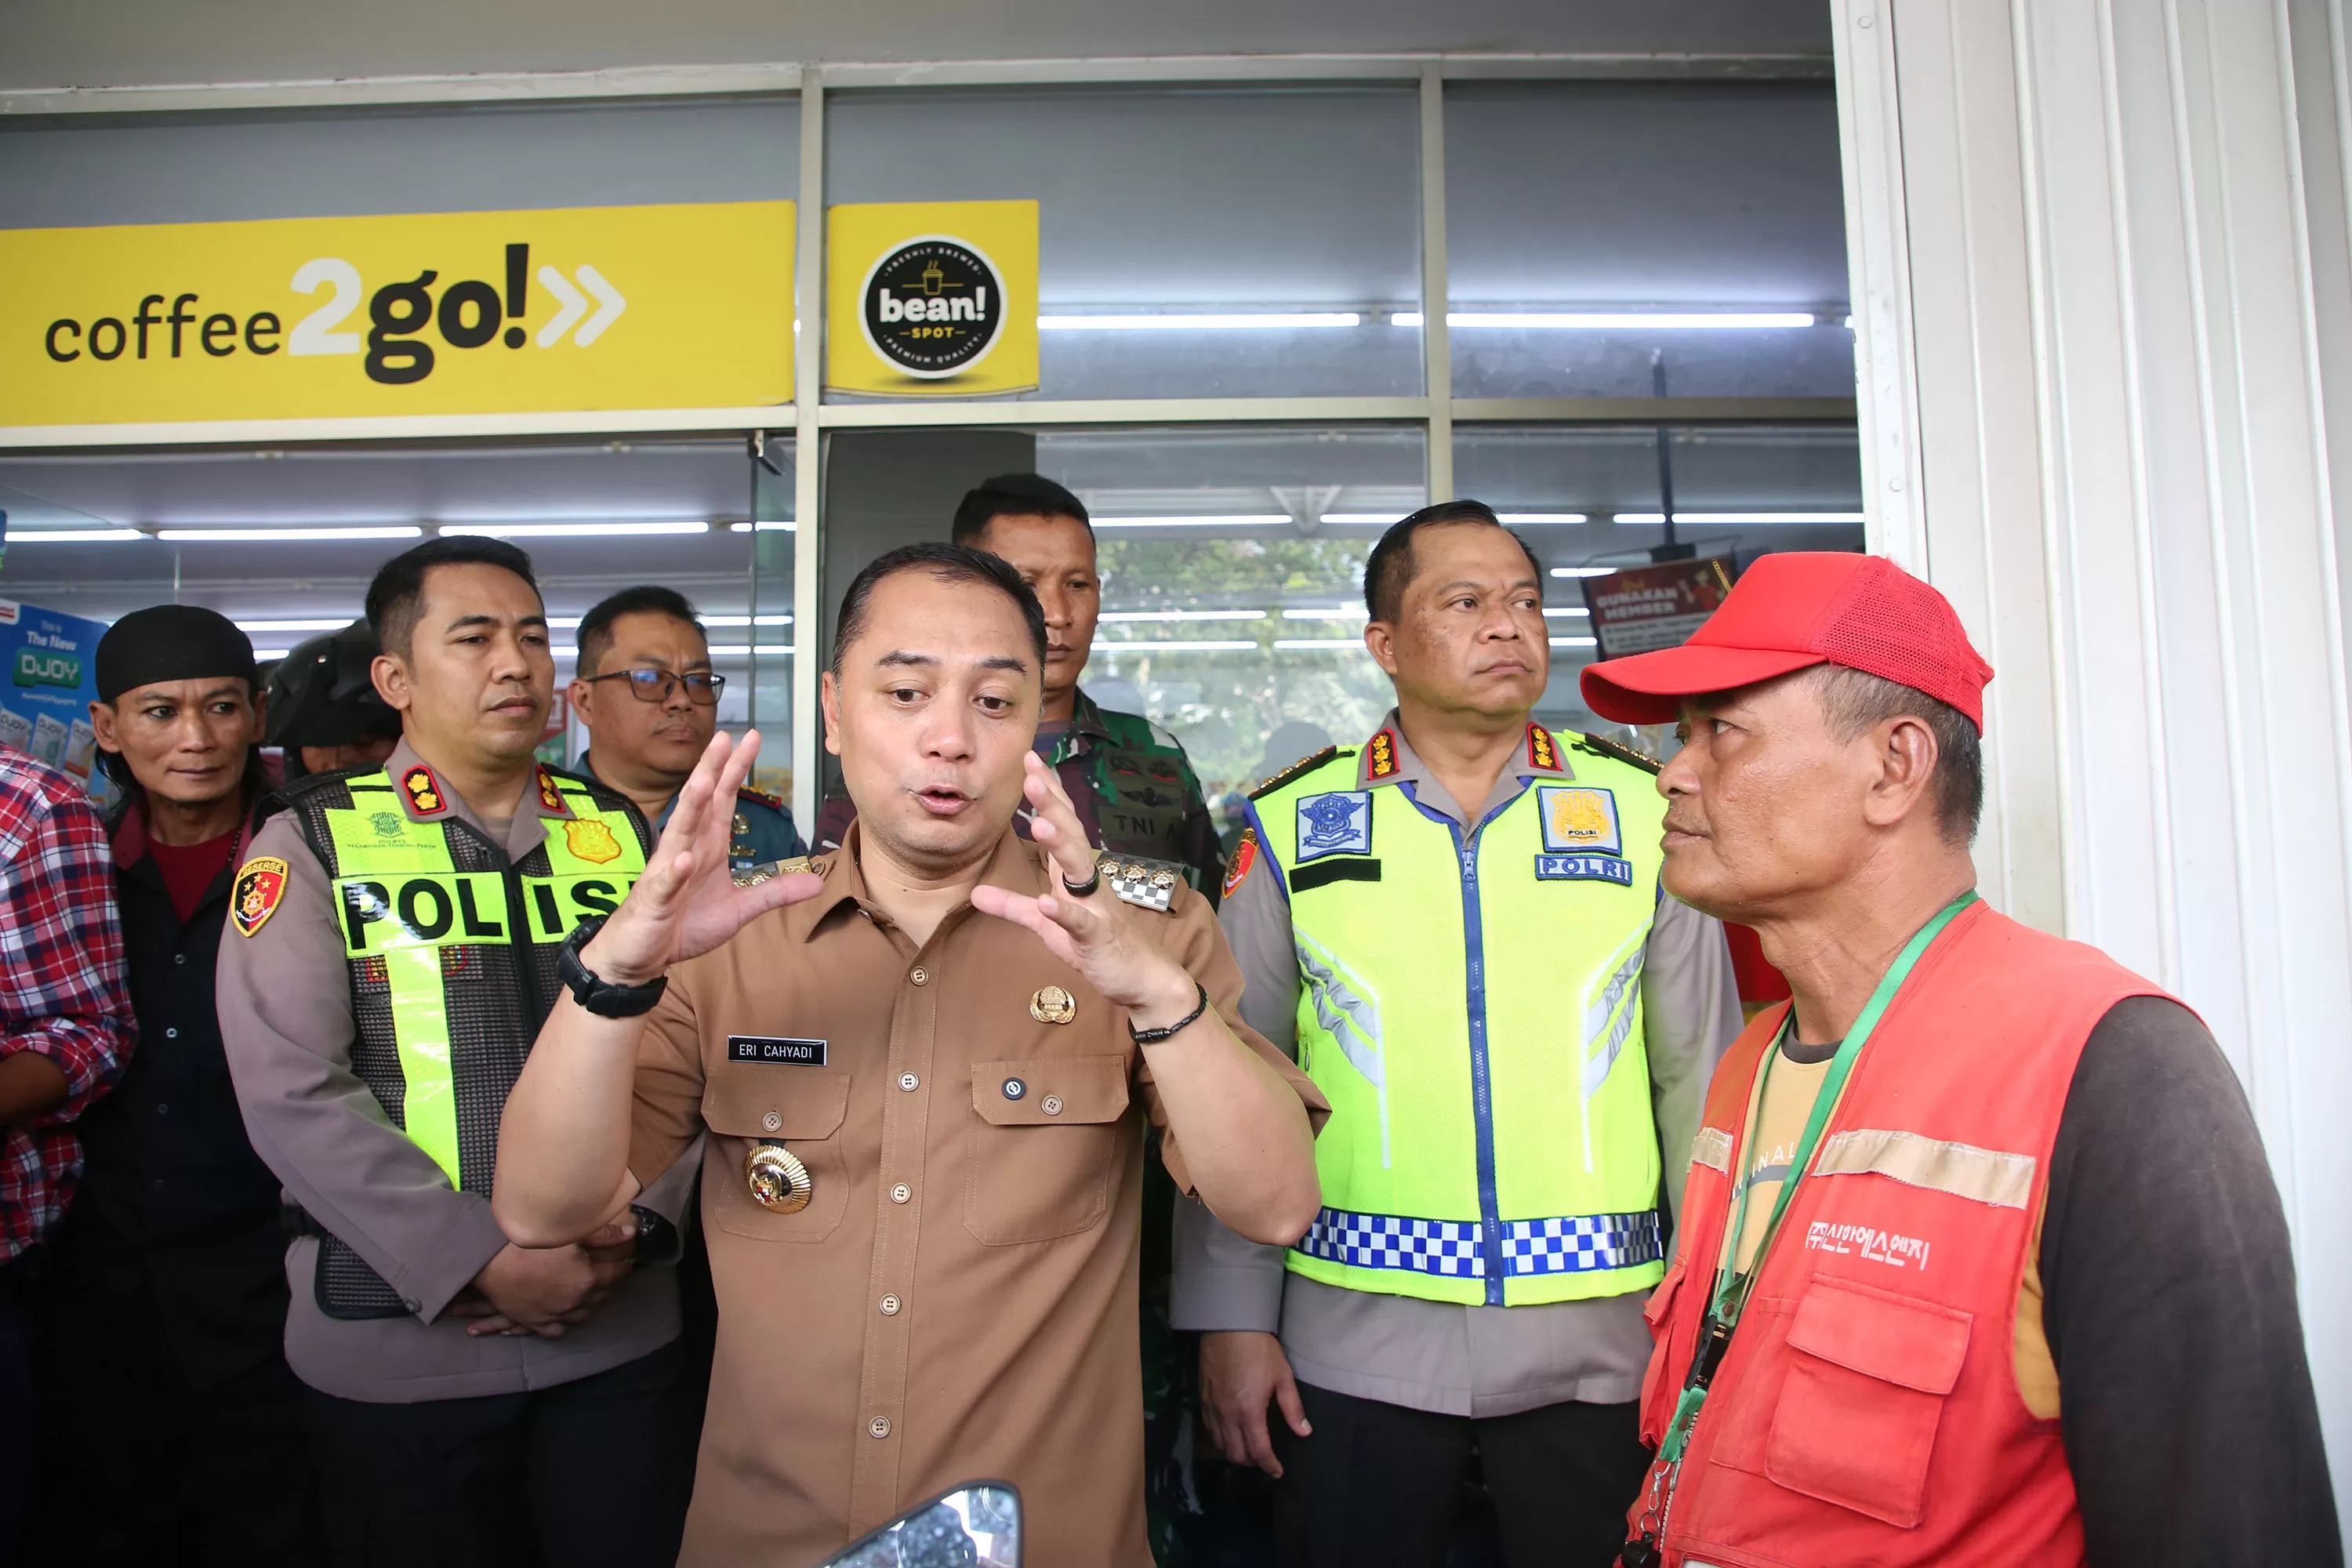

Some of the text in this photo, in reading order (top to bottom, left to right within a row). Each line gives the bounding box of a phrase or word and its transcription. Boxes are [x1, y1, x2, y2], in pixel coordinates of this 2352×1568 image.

[886, 246, 980, 273] FRESHLY BREWED
[879, 285, 986, 322] bean!
[911, 326, 955, 339] SPOT
[885, 336, 979, 364] PREMIUM QUALITY
[27, 630, 78, 652] The New
[21, 654, 78, 681] DJOY
[1113, 815, 1155, 835] TNI
[1542, 857, 1624, 880] POLRI
[341, 878, 619, 950] POLIS
[739, 1044, 812, 1059] ERI CAHYADI
